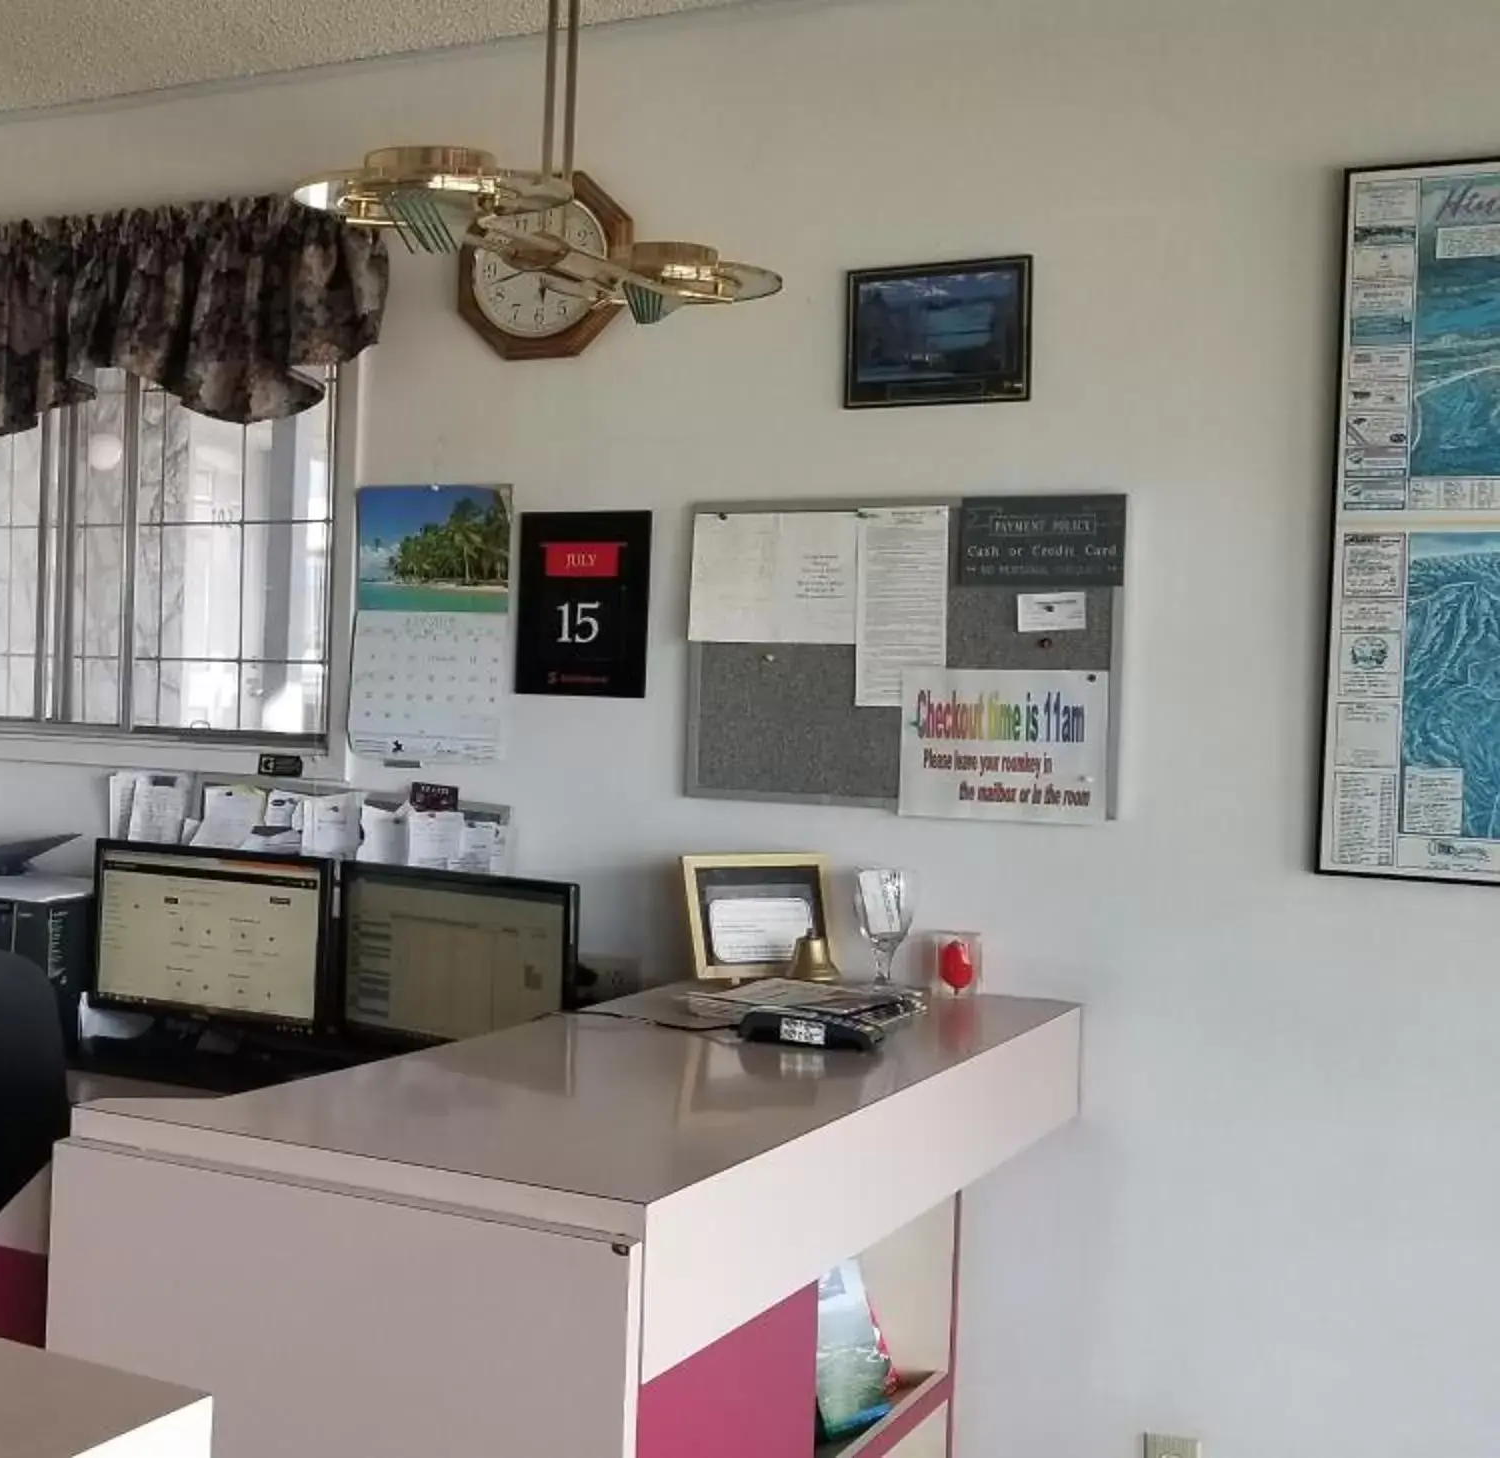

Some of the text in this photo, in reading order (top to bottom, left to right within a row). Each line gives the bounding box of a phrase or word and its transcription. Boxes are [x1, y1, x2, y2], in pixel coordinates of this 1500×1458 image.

[511, 303, 521, 321] 7
[994, 519, 1046, 534] PAYMENT
[566, 553, 597, 569] JULY
[966, 543, 1118, 559] Cash or Credit Card
[555, 600, 602, 643] 15
[916, 689, 1086, 743] Checkout time is 11am
[923, 747, 1053, 779] Please leave your roomkey in
[958, 781, 1091, 808] the mailbox or in the room
